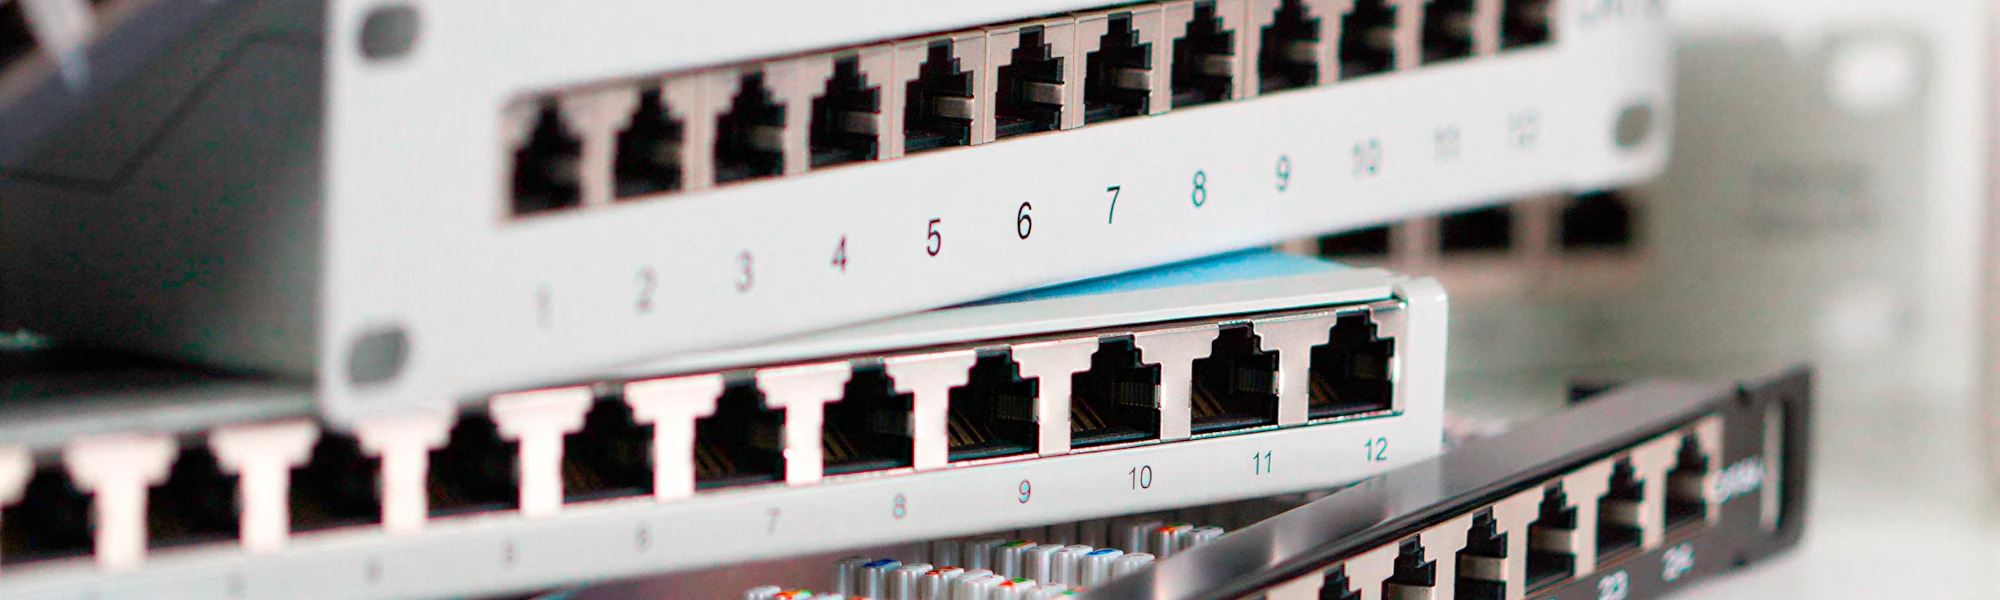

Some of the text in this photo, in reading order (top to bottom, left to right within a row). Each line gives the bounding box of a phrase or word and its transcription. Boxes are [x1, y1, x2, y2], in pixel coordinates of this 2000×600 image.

[634, 266, 657, 315] 2
[734, 250, 755, 294] 3
[830, 234, 848, 273] 4
[926, 218, 942, 257] 5
[1016, 201, 1033, 240] 6
[1106, 185, 1121, 225] 7
[1191, 169, 1207, 208] 8
[1276, 154, 1291, 193] 9
[1351, 138, 1382, 176] 10
[766, 508, 782, 534] 7
[892, 493, 907, 520] 8
[1018, 480, 1032, 505] 9
[1128, 465, 1153, 491] 10
[1252, 450, 1273, 476] 11
[1364, 436, 1388, 462] 12
